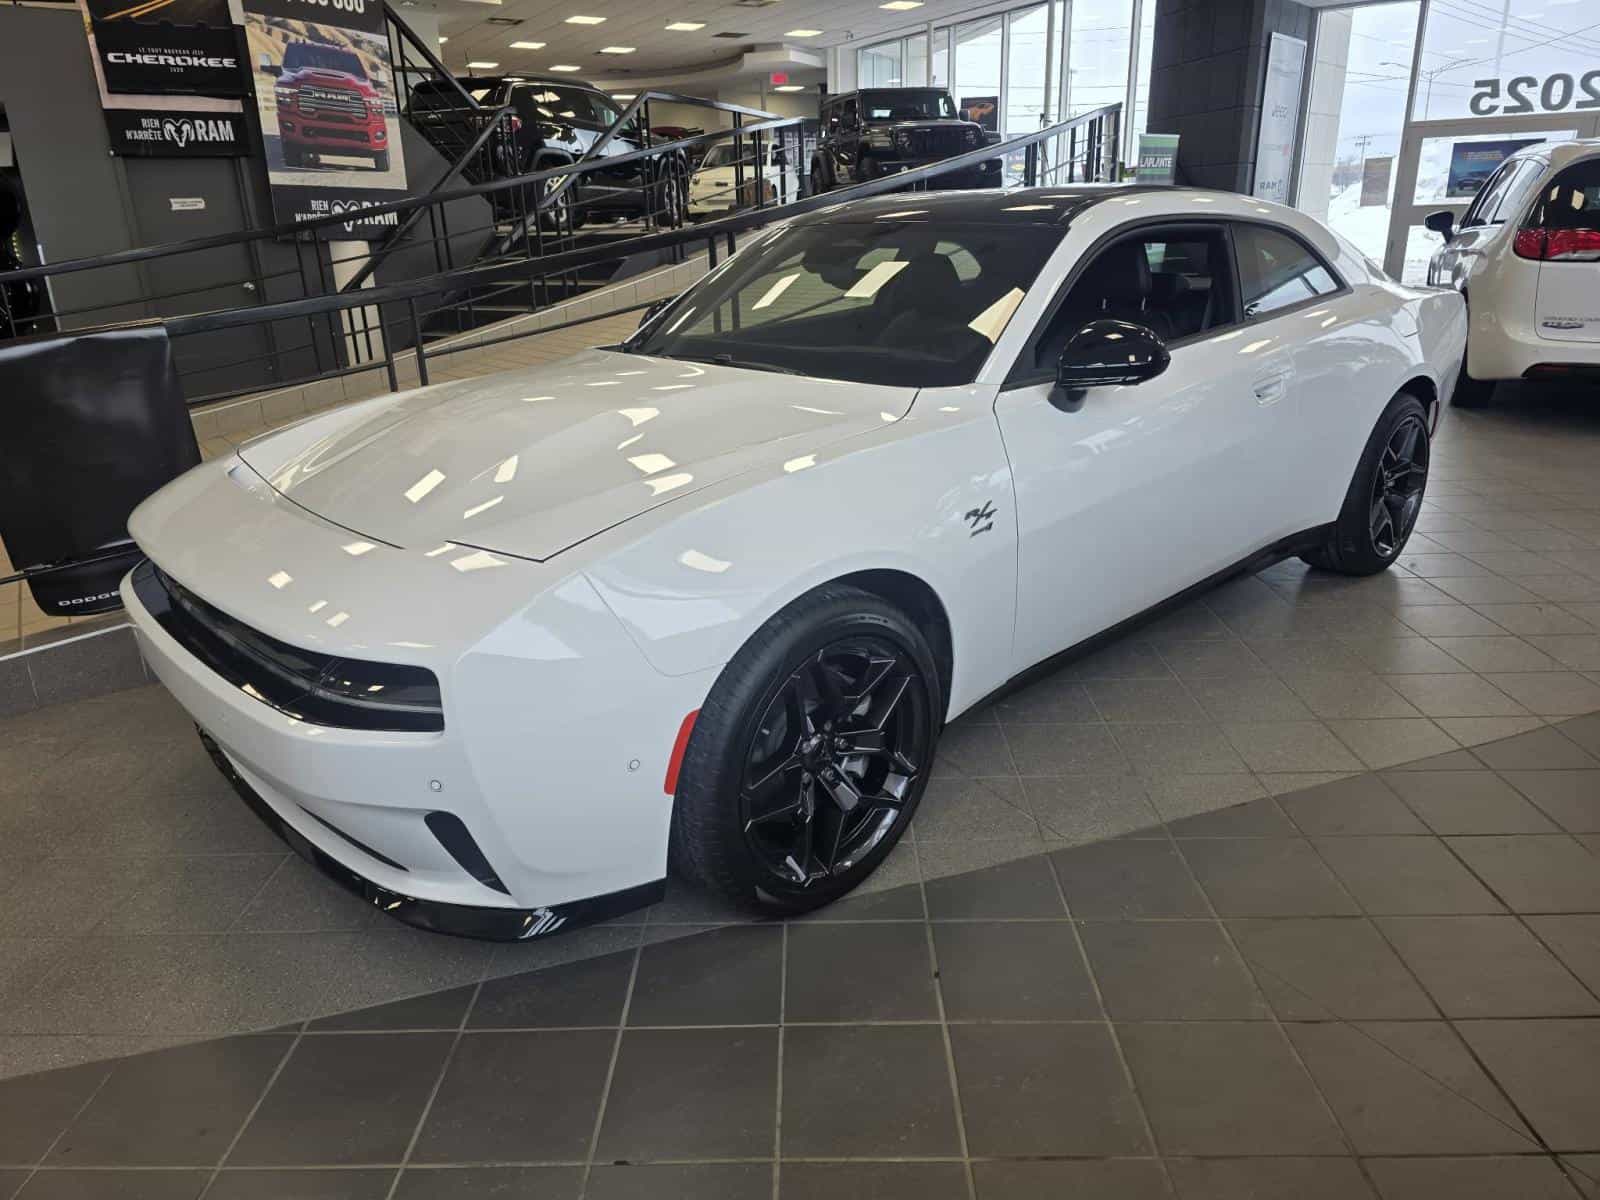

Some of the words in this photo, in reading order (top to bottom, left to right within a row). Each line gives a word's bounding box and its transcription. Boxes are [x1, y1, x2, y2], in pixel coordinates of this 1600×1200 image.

[107, 52, 238, 68] CHEROKEE
[141, 118, 160, 129] RIEN
[125, 128, 163, 141] N'ARRÊTE
[194, 119, 236, 142] RAM
[1140, 157, 1172, 168] LAPLANTE
[310, 199, 329, 211] RIEN
